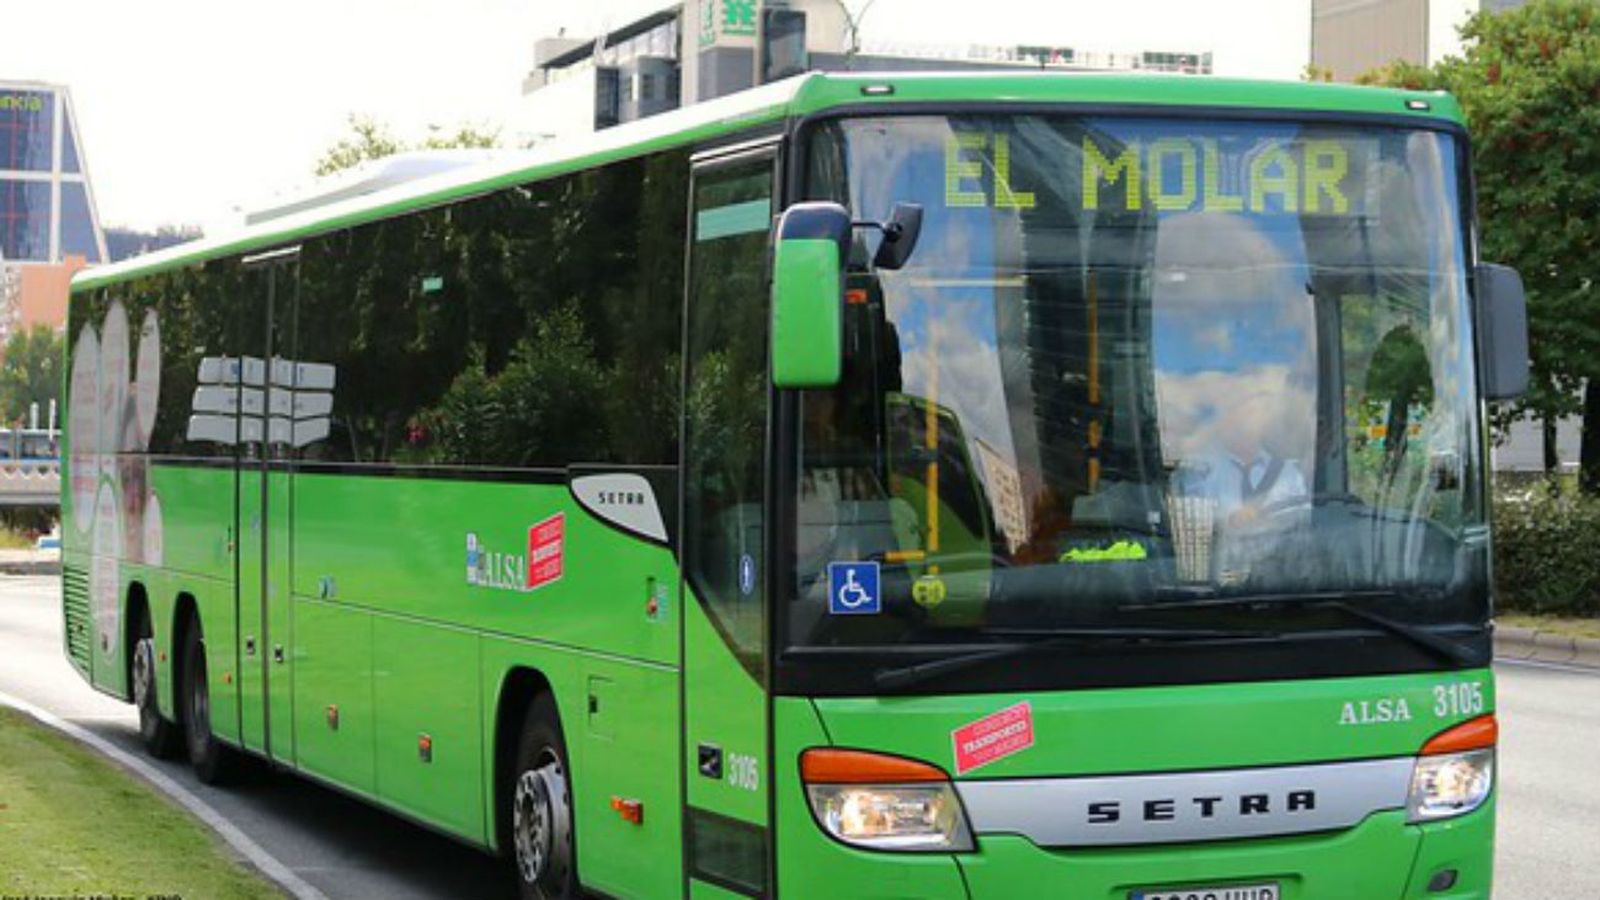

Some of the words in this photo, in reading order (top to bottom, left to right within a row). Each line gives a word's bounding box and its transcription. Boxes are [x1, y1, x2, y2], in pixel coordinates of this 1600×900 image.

[945, 134, 1035, 208] EL
[1081, 137, 1350, 214] MOLAR
[599, 491, 644, 505] SETRA
[1339, 698, 1412, 725] ALSA
[1433, 682, 1483, 717] 3105
[728, 752, 759, 792] 3105
[1087, 790, 1316, 824] SETRA
